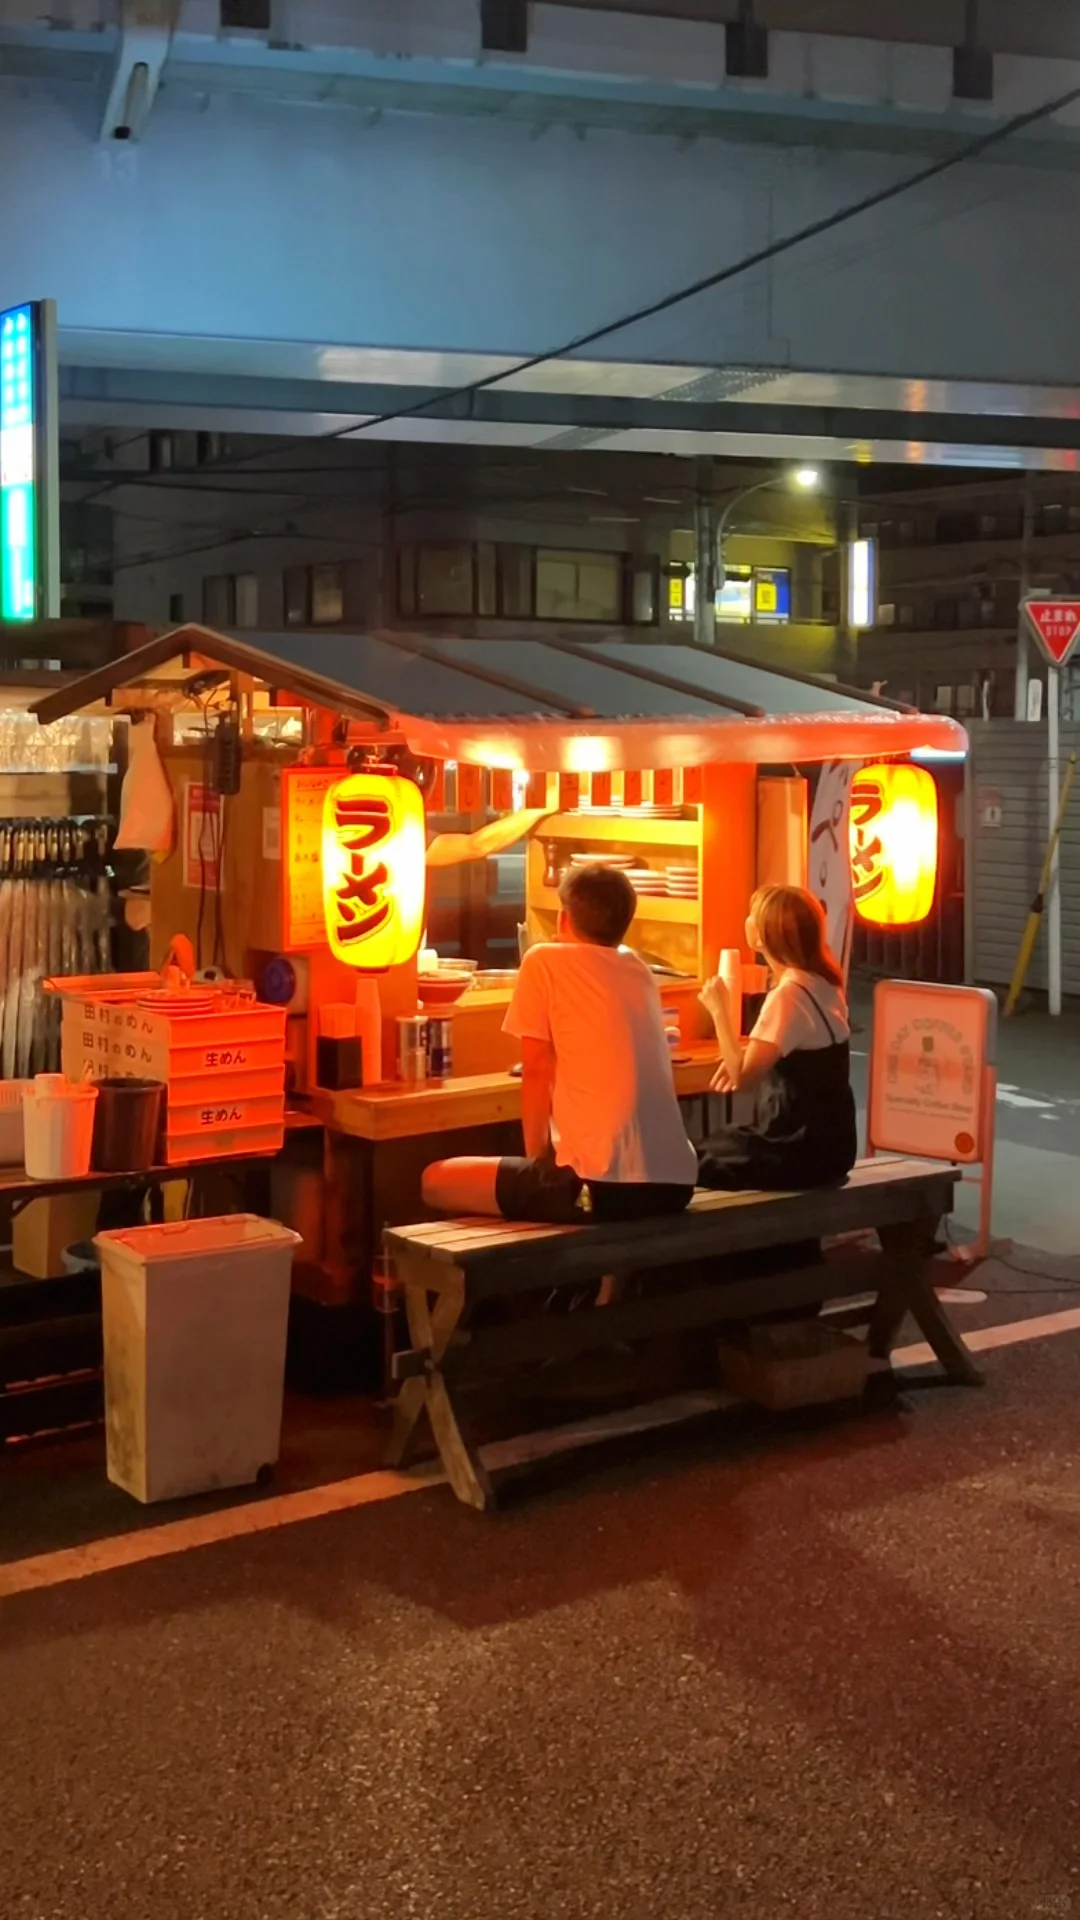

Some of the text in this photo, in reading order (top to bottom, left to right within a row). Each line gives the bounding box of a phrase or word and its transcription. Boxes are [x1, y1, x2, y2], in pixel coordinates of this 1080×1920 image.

[1040, 609, 1077, 622] 止まれ
[1046, 625, 1071, 637] STOP
[851, 782, 885, 903] ラーメン
[335, 797, 393, 944] ラーメン
[84, 1004, 153, 1034] 田村のめん
[912, 1018, 963, 1044] COFFEE
[82, 1032, 152, 1063] 田村のめん
[205, 1050, 246, 1067] 生めん
[201, 1108, 242, 1125] 生めん
